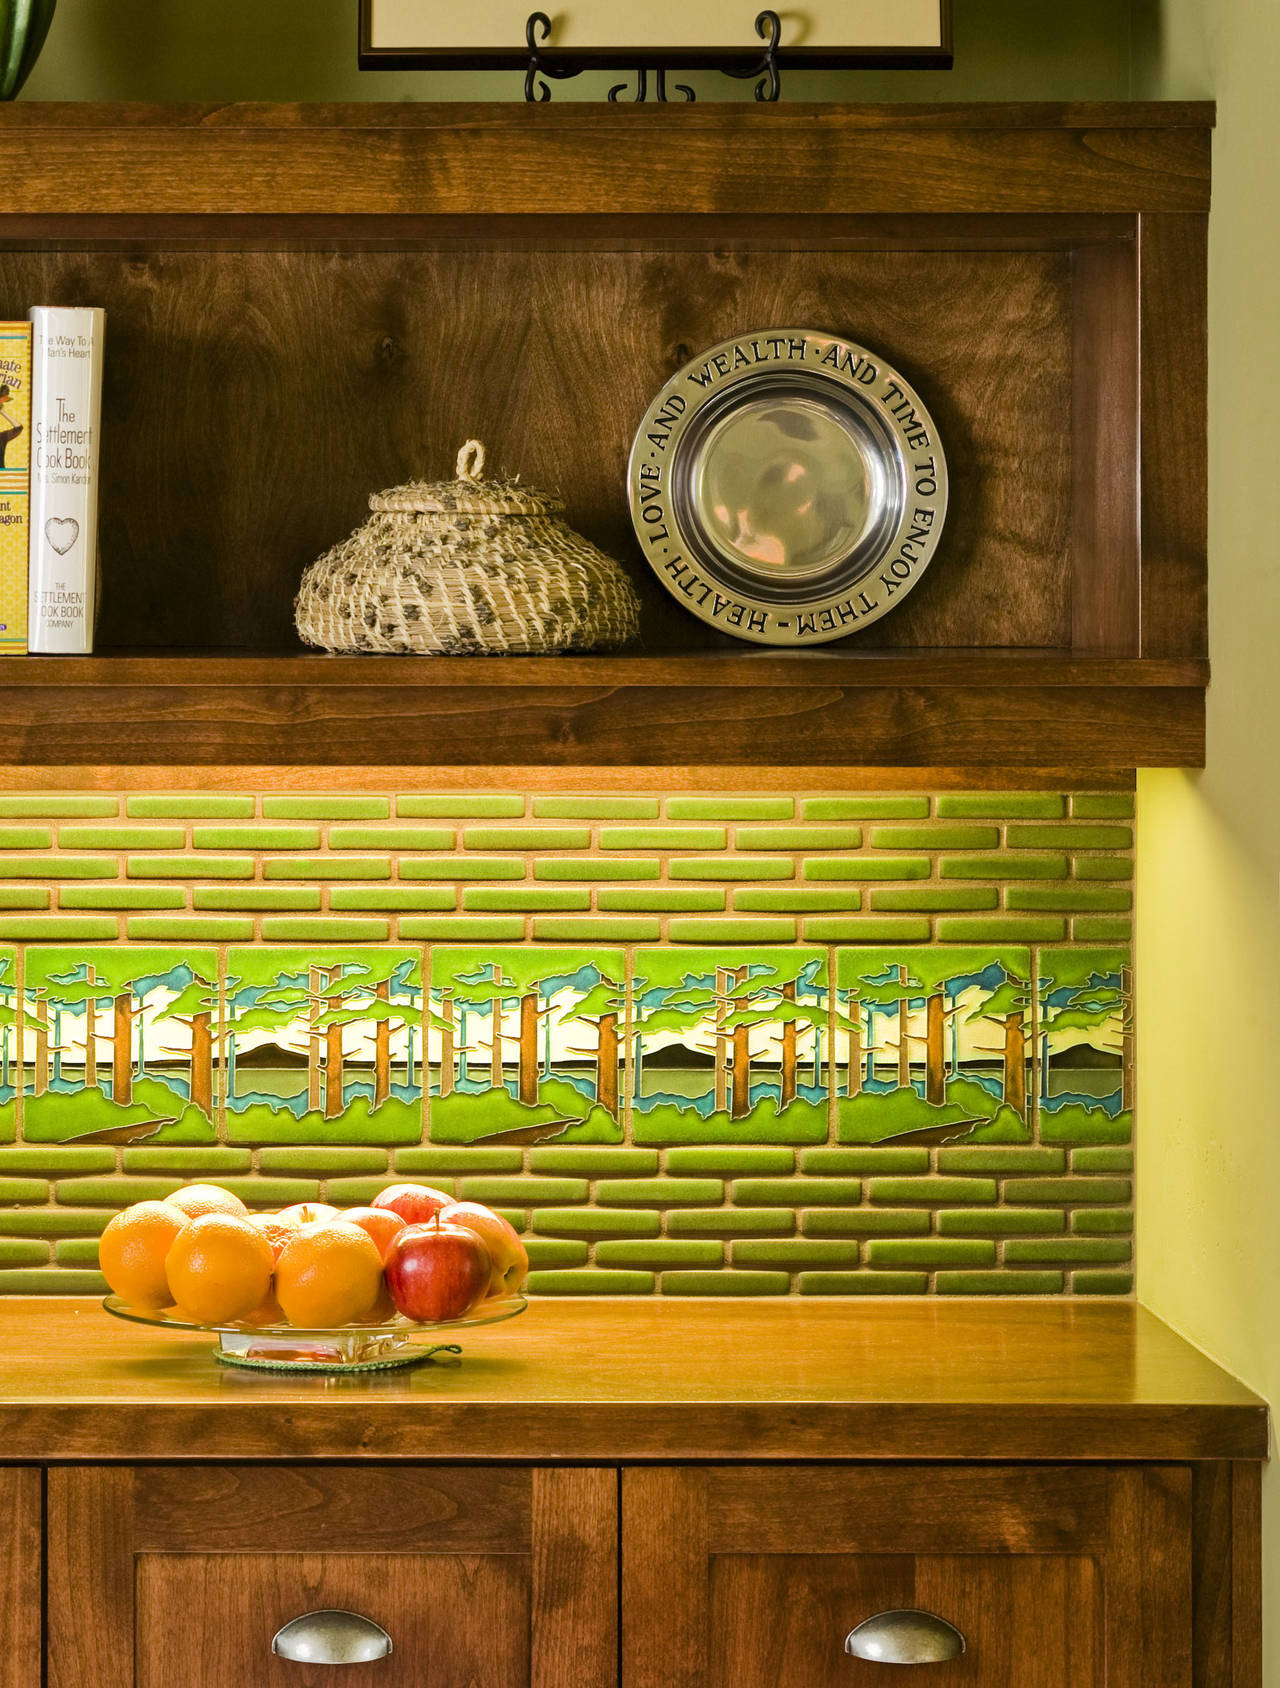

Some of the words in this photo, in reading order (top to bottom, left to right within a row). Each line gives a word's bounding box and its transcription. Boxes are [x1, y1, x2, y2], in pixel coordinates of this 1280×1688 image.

[55, 335, 75, 348] Way
[77, 335, 88, 346] To
[687, 338, 807, 389] WEALTH
[820, 344, 878, 386] AND
[55, 398, 75, 422] The
[650, 393, 688, 451] AND
[879, 382, 930, 451] TIME
[51, 473, 70, 485] Simon
[914, 456, 937, 497] TO
[638, 462, 670, 545] LOVE
[878, 507, 935, 596] ENJOY
[55, 582, 66, 591] THE
[664, 554, 768, 633] HEALTH
[60, 605, 84, 618] BOOK
[796, 591, 880, 636] THEM
